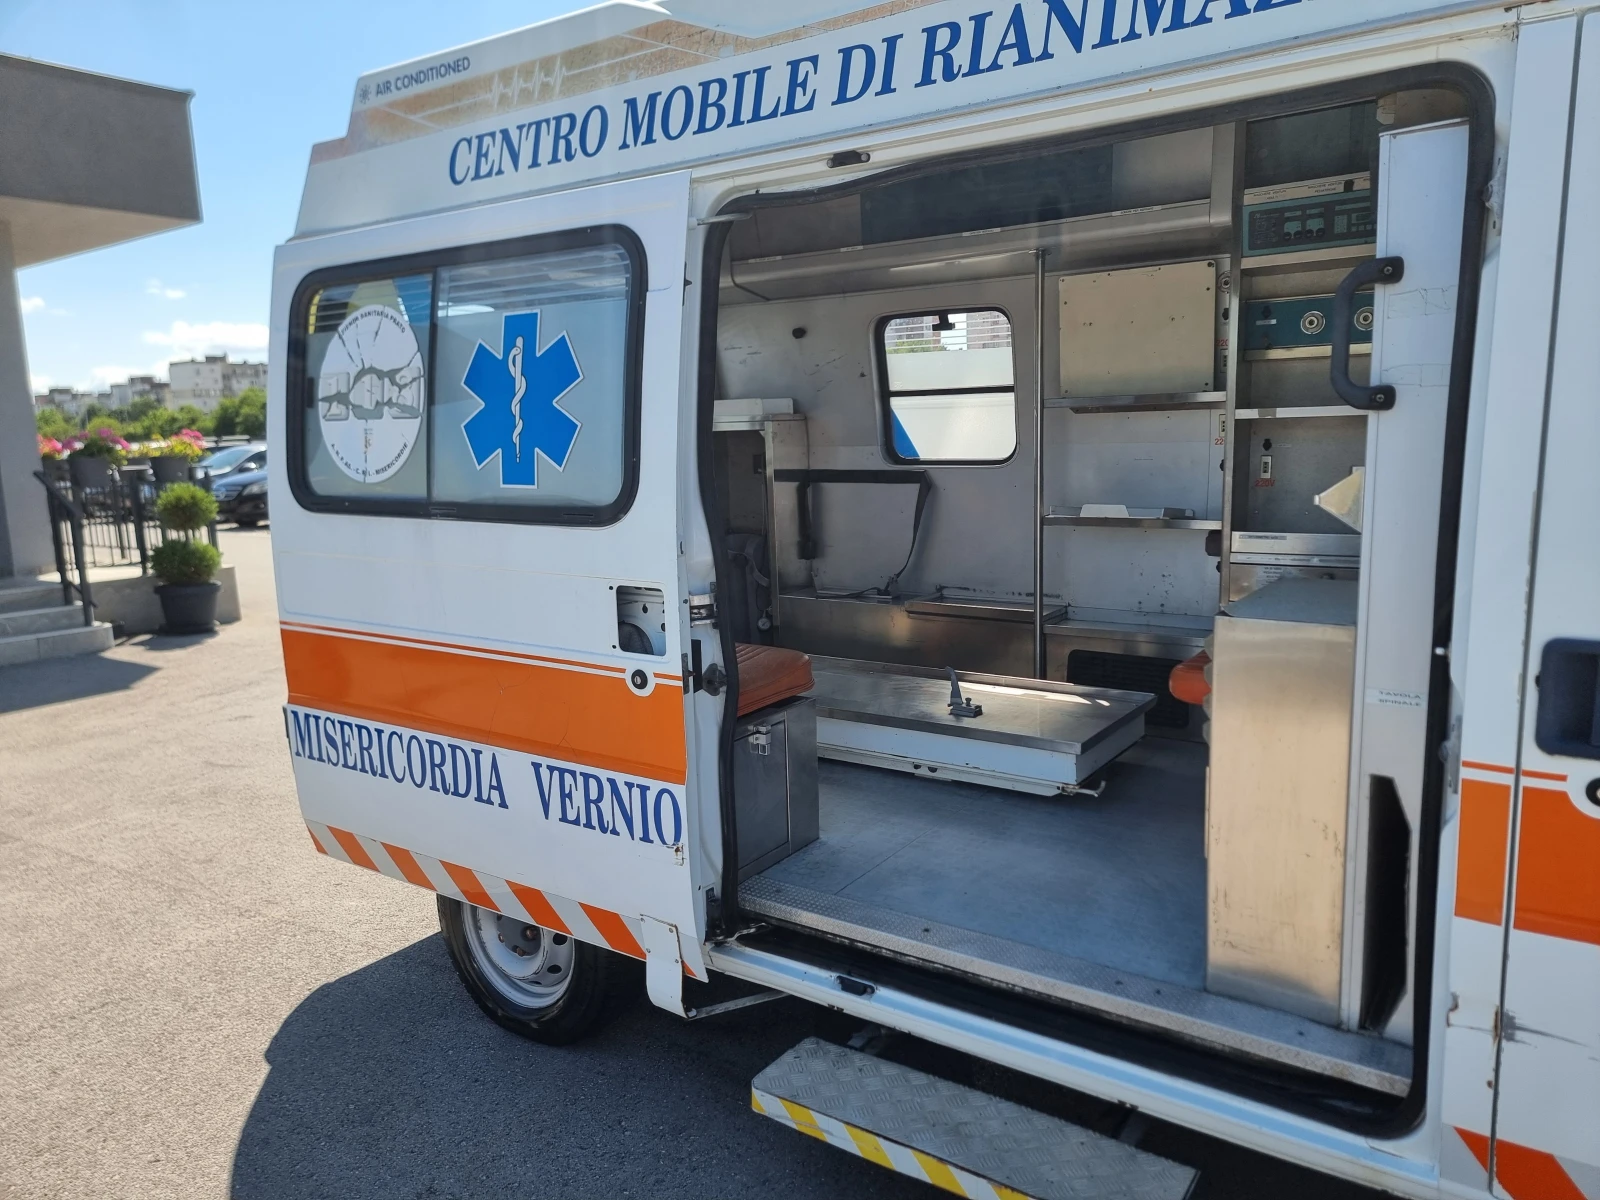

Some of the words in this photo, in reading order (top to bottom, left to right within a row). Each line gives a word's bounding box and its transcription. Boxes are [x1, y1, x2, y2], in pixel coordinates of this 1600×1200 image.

[375, 79, 393, 97] AIR
[394, 56, 471, 92] CONDITIONED
[448, 104, 610, 186] CENTRO
[618, 53, 820, 151] MOBILE
[831, 33, 904, 106] DI
[1379, 690, 1421, 699] TAVOLA
[1379, 697, 1421, 706] SPINALE
[290, 709, 509, 810] MISERICORDIA
[530, 761, 683, 849] VERNIO
